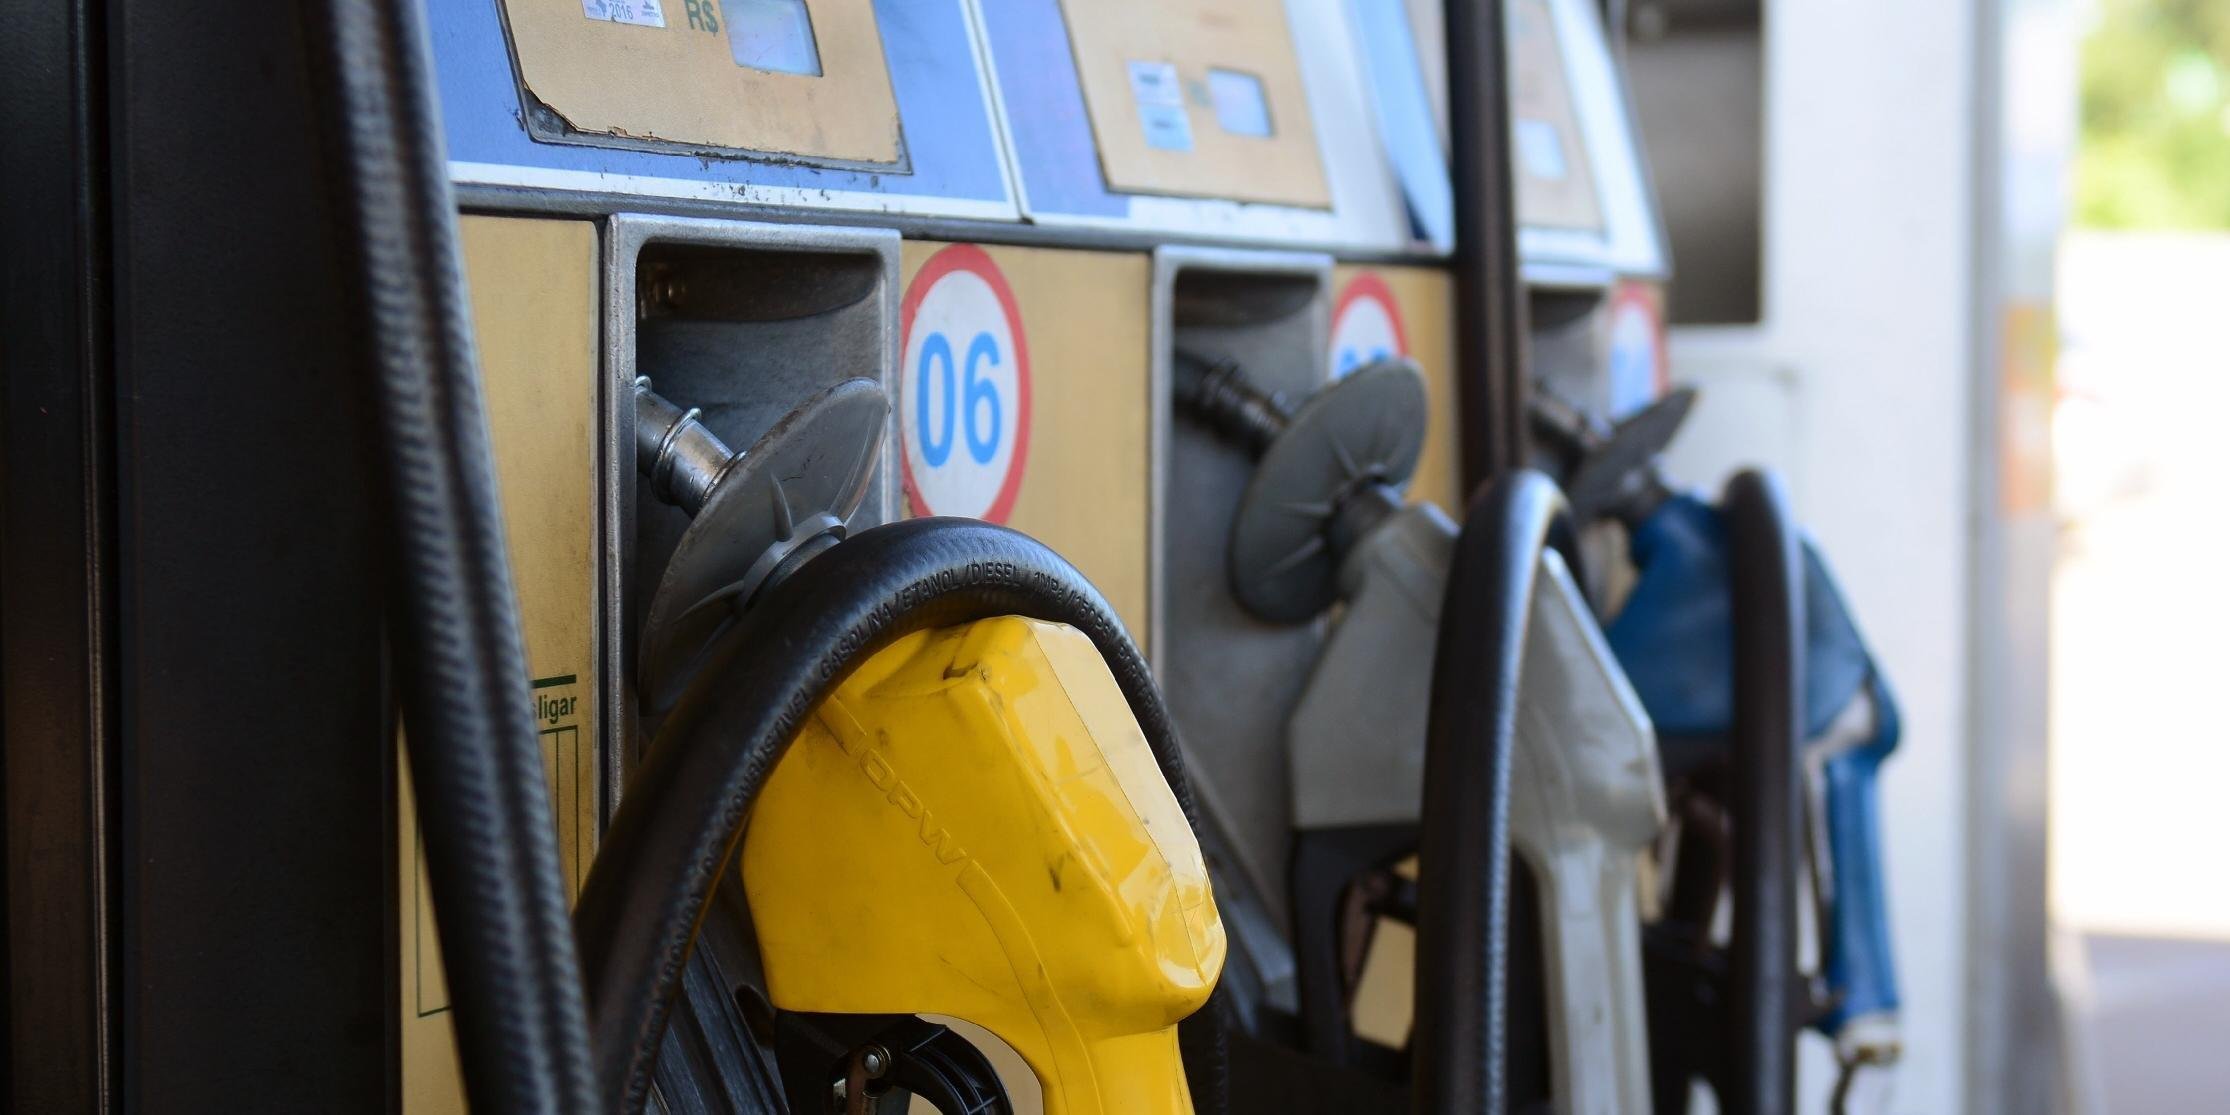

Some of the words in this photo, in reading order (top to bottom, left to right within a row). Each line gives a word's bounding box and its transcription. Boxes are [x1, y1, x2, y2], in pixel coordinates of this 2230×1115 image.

[609, 3, 634, 20] 2016
[684, 0, 719, 37] R$
[917, 332, 1001, 467] 06
[860, 748, 967, 866] OPW
